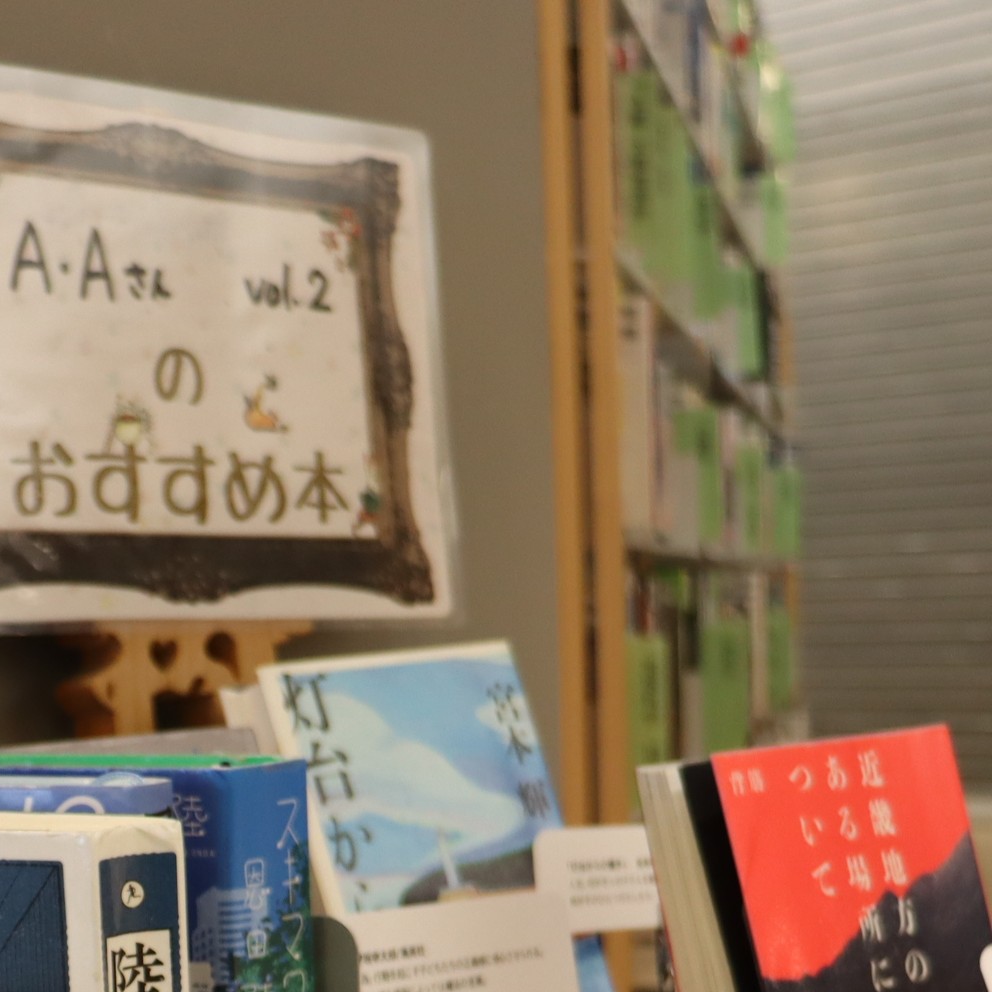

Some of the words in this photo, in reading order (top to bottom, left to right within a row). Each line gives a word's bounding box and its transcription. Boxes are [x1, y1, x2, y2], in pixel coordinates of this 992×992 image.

[244, 262, 333, 312] vol.2
[155, 347, 204, 406] の
[10, 440, 350, 526] おすすめ本
[788, 765, 838, 897] ついて
